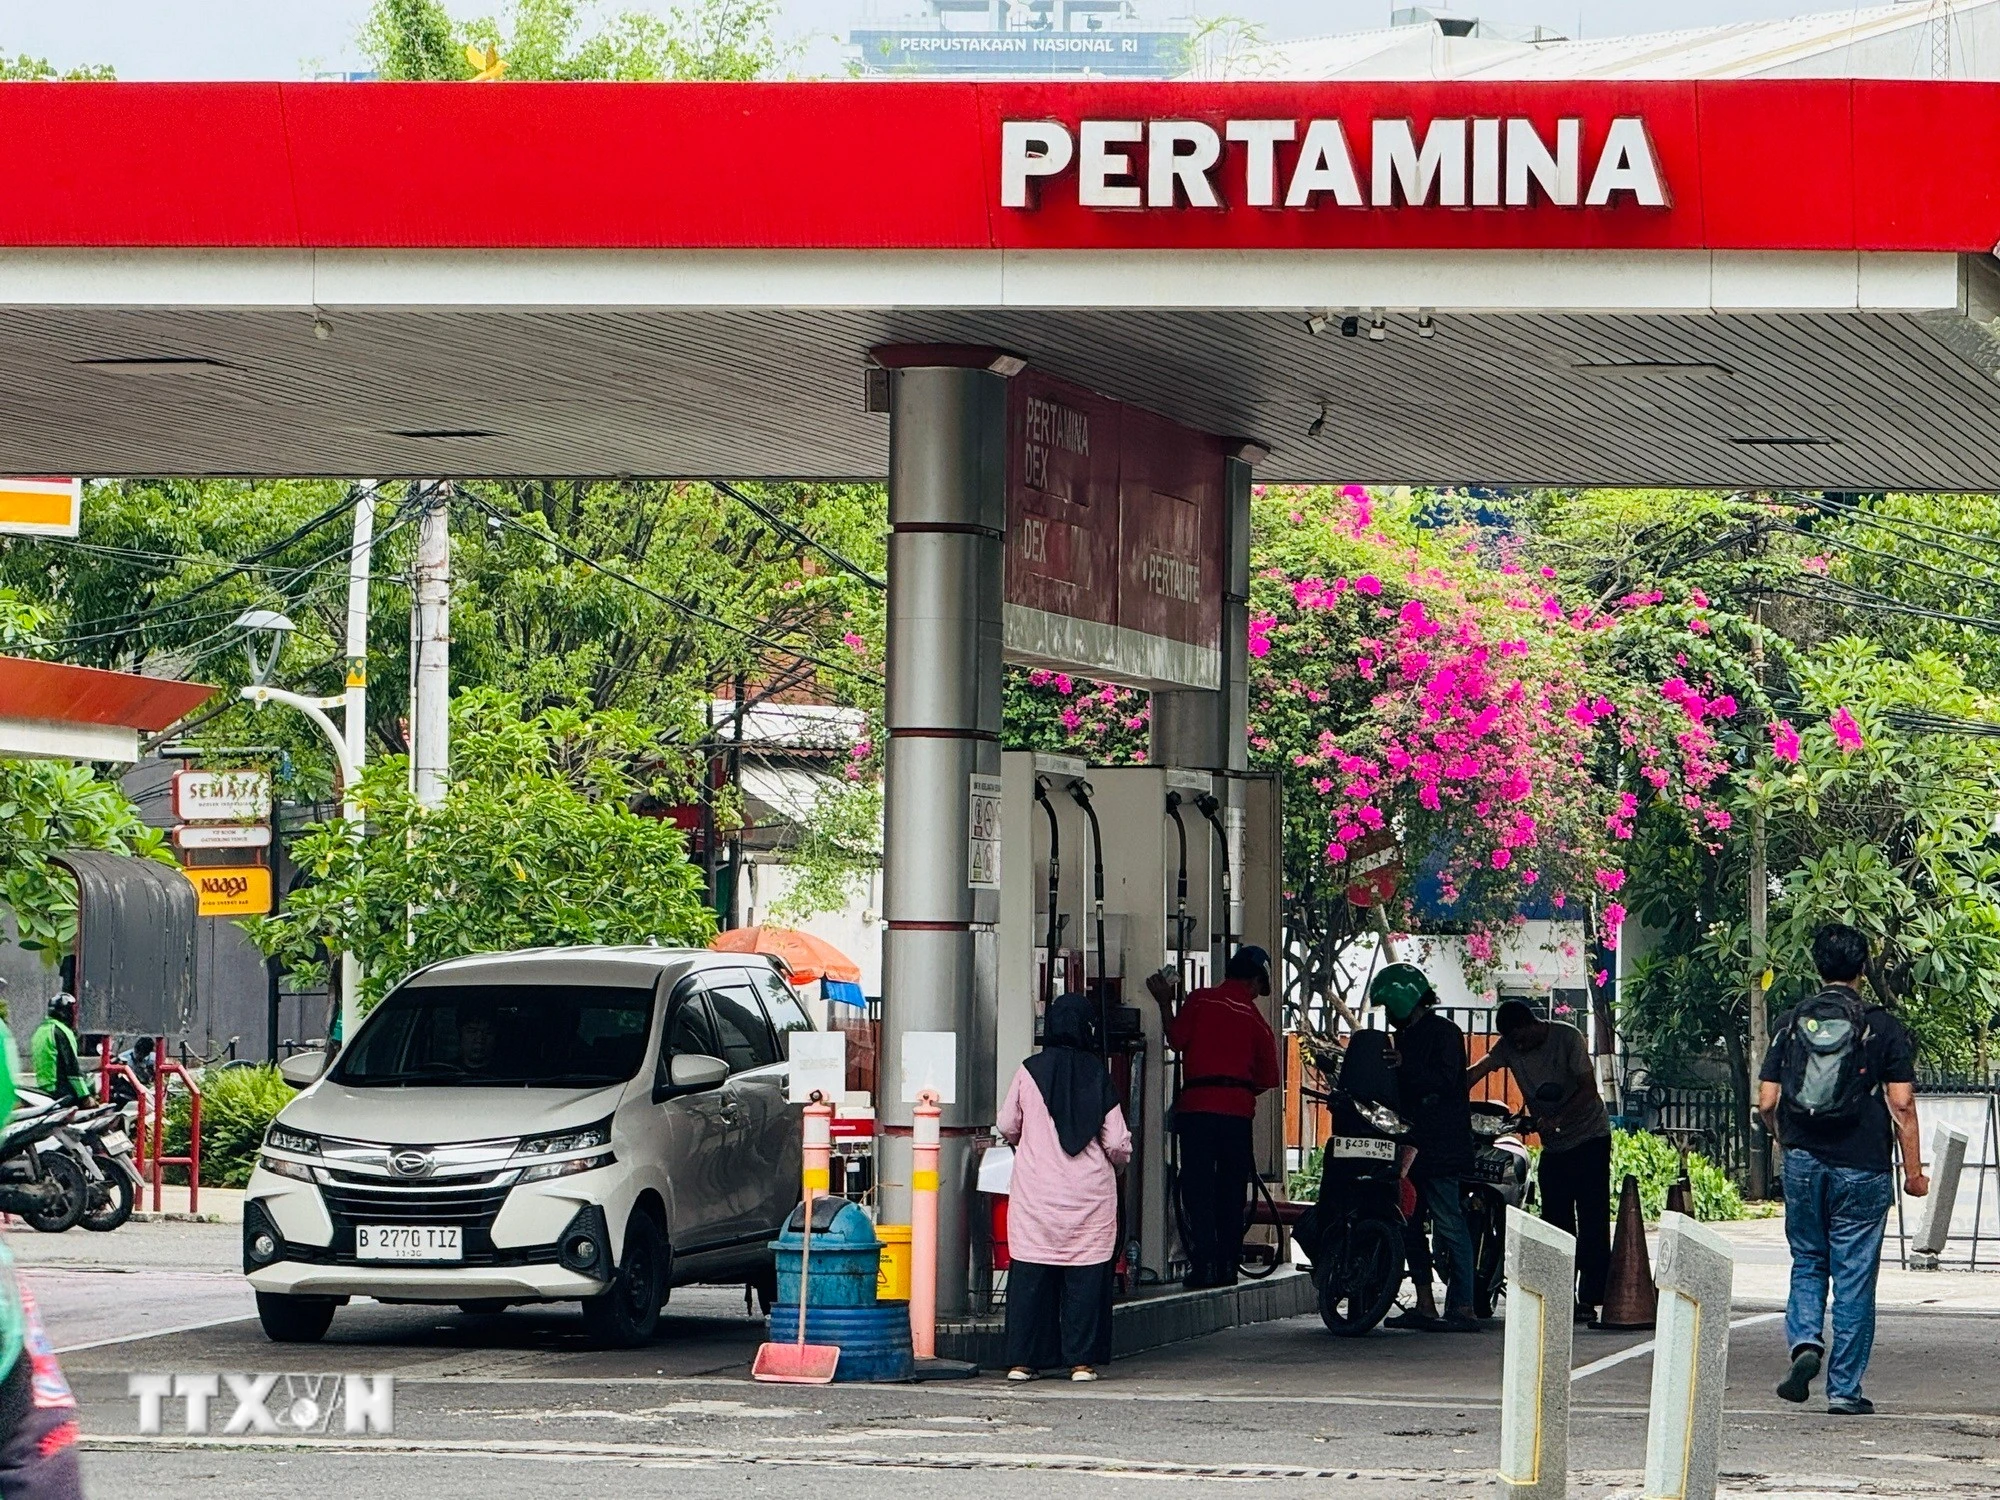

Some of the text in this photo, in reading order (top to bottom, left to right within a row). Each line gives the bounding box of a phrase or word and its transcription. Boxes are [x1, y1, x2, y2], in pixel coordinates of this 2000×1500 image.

[900, 37, 1138, 53] PERPUSTAKAAN NASIONAL RI
[1001, 117, 1667, 209] PERTAMINA
[1026, 396, 1090, 458] PERTAMINA
[1025, 442, 1050, 490] DEX
[1023, 518, 1047, 564] DEX
[1335, 1138, 1342, 1147] B
[359, 1229, 457, 1248] B 2770 TIZ
